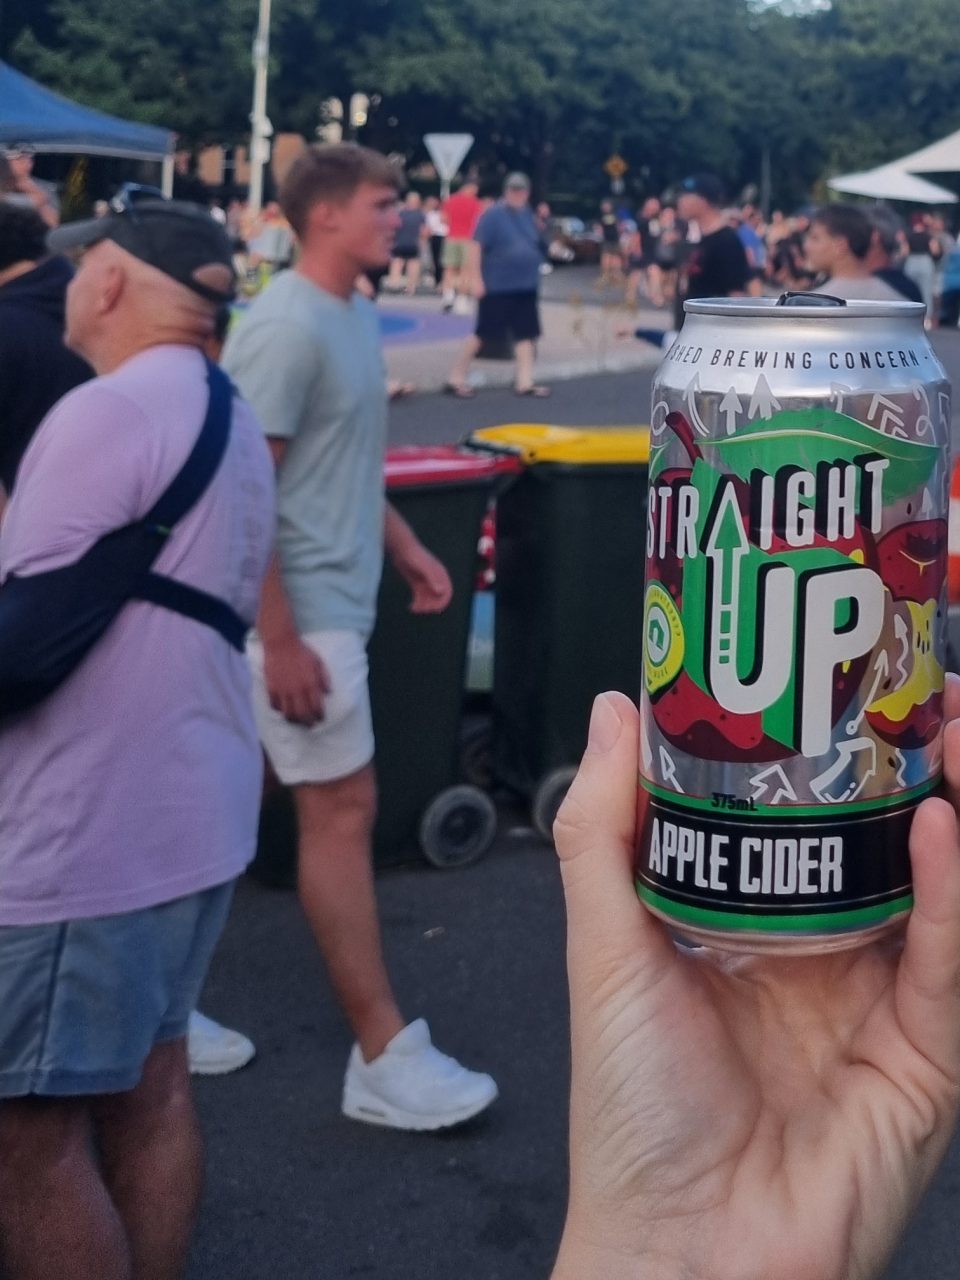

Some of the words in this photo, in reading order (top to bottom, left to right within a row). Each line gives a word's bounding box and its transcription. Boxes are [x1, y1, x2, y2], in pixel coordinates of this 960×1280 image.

[709, 348, 812, 370] BREWING
[828, 348, 920, 370] CONCERN
[647, 458, 890, 560] STRAIGHT
[709, 566, 886, 758] UP
[711, 791, 758, 812] 375mL
[648, 817, 730, 891] APPLE
[739, 835, 844, 895] CIDER
